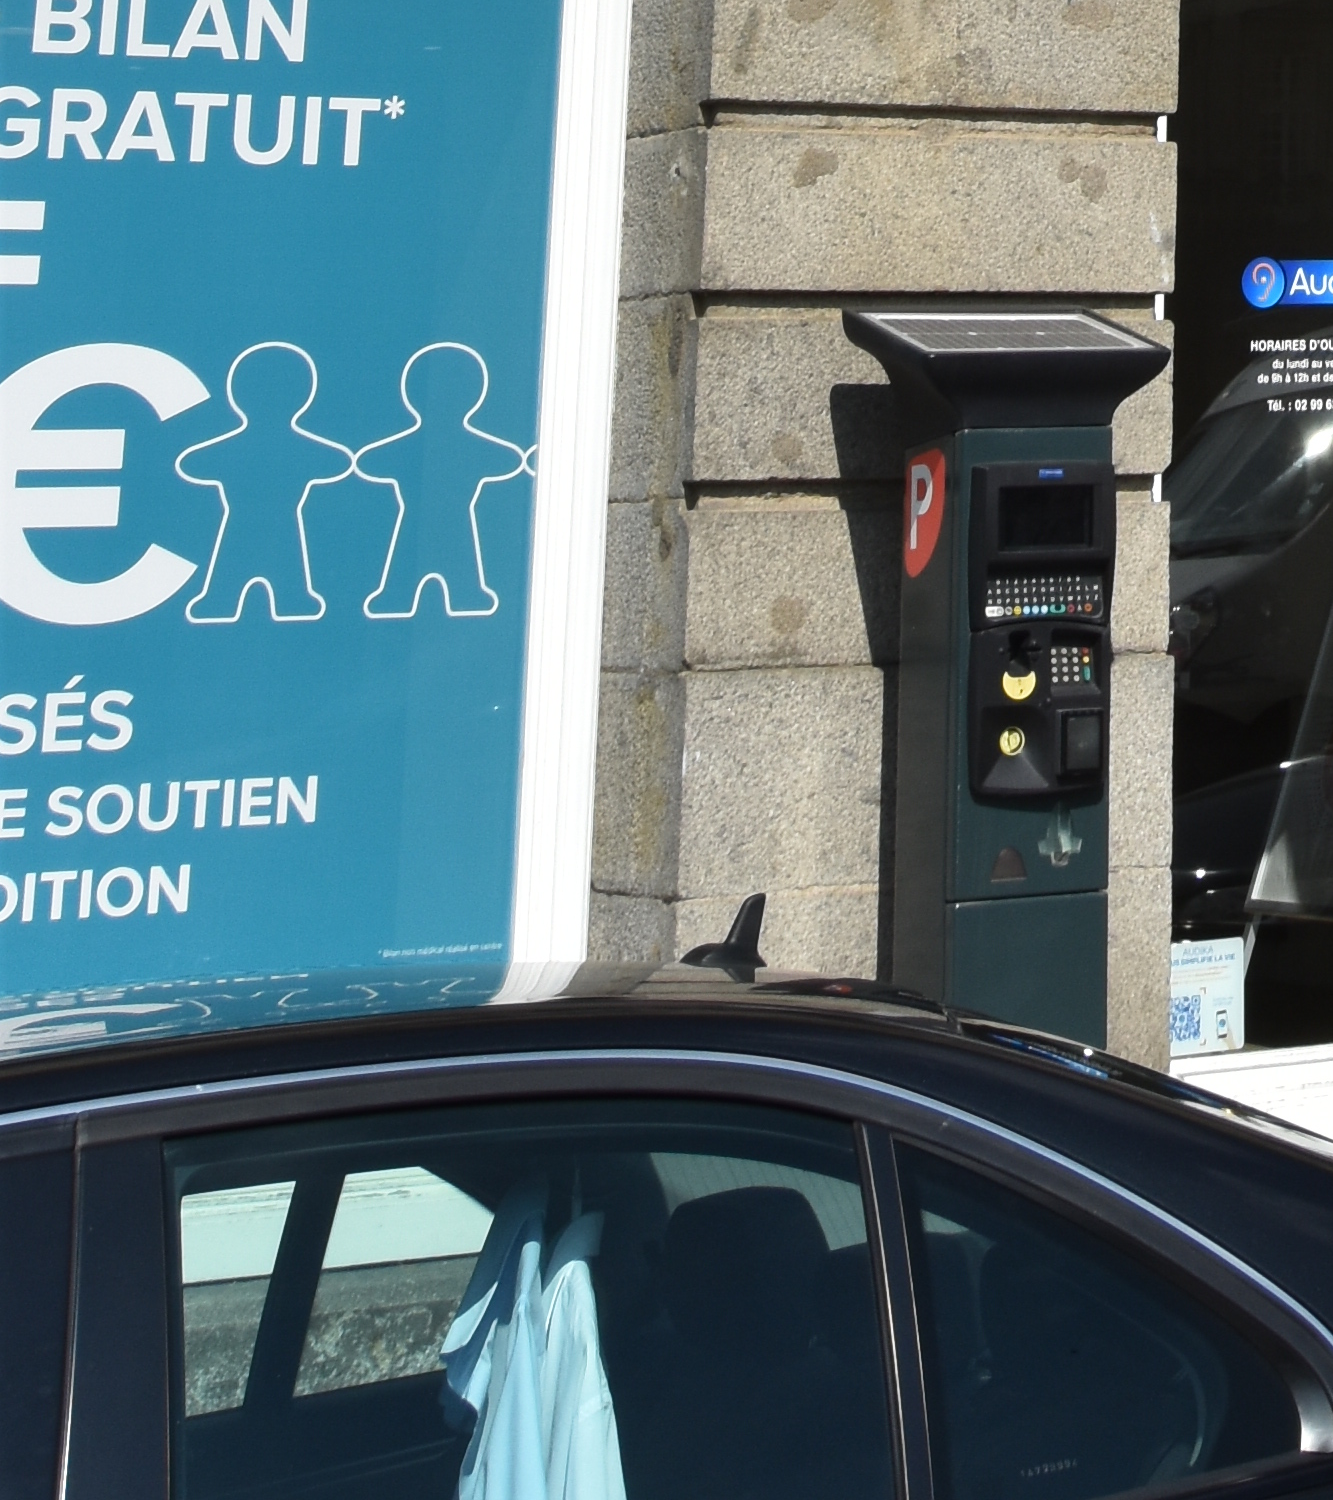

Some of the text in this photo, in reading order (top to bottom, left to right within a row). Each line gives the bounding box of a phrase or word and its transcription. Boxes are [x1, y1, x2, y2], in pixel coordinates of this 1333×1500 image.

[1250, 339, 1306, 352] HORAIRES
[1272, 359, 1284, 369] du
[1287, 358, 1309, 369] lundi
[1311, 360, 1323, 368] au
[1257, 373, 1269, 384] de
[1285, 372, 1291, 383] à
[1294, 372, 1309, 383] 12h
[1312, 373, 1321, 383] et
[1267, 400, 1285, 412] Tél.
[1295, 399, 1308, 411] 02
[1310, 398, 1323, 411] 99
[910, 464, 933, 550] P
[45, 775, 319, 836] SOUTIEN
[1183, 946, 1214, 956] AUDIKA
